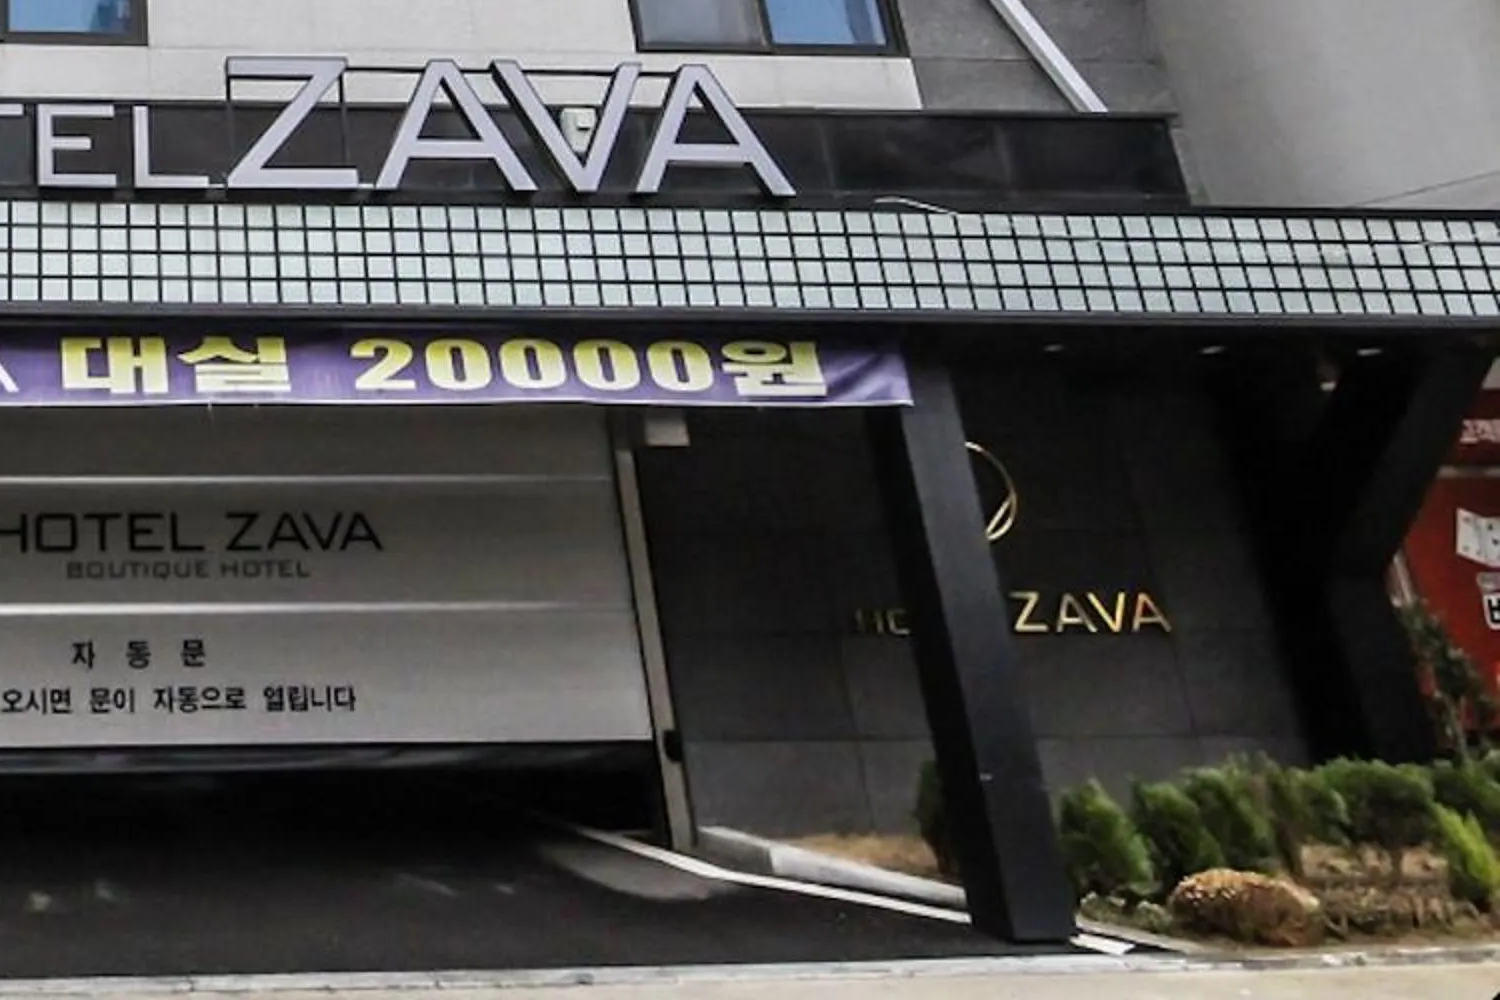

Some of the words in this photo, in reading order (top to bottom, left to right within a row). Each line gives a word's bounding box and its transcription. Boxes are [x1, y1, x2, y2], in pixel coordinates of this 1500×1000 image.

[224, 56, 798, 198] ZAVA
[58, 335, 292, 395] 대실
[348, 337, 828, 398] 20000원
[223, 511, 384, 553] ZAVA
[66, 559, 209, 581] BOUTIQUE
[220, 559, 311, 579] HOTEL
[1007, 591, 1173, 634] ZAVA
[0, 688, 74, 715] 오시면
[88, 687, 136, 714] 문이
[152, 686, 247, 713] 자동으로
[262, 685, 358, 713] 열립니다
